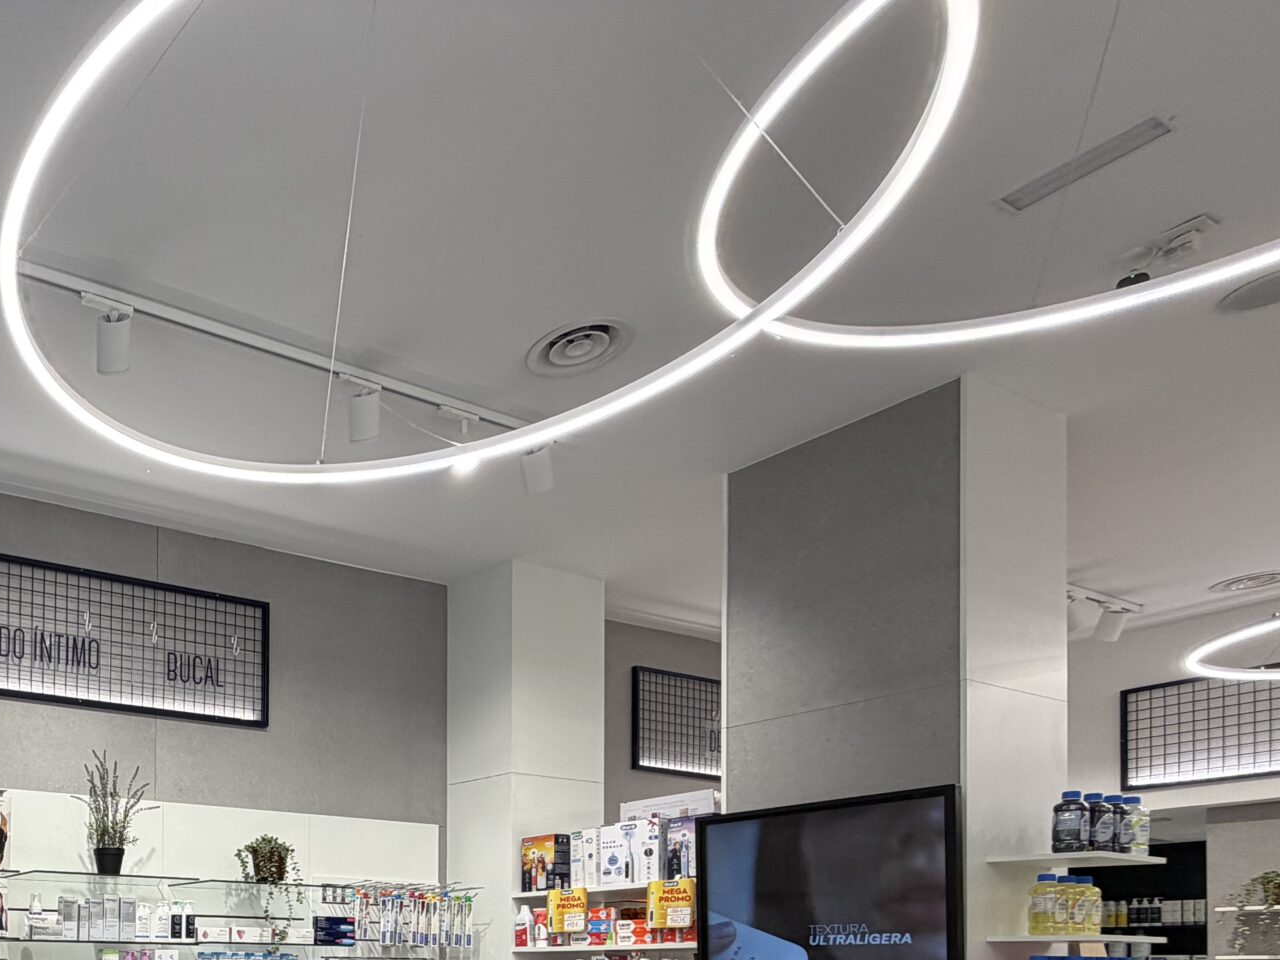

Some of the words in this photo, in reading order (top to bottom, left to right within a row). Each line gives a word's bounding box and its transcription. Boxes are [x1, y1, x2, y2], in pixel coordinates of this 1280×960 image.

[32, 625, 101, 670] ÍNTIMO
[166, 652, 225, 688] BUCAL
[658, 895, 691, 903] PROMO
[556, 902, 585, 910] PROMO
[808, 924, 869, 935] TEXTURA
[808, 933, 912, 946] ULTRALIGERA
